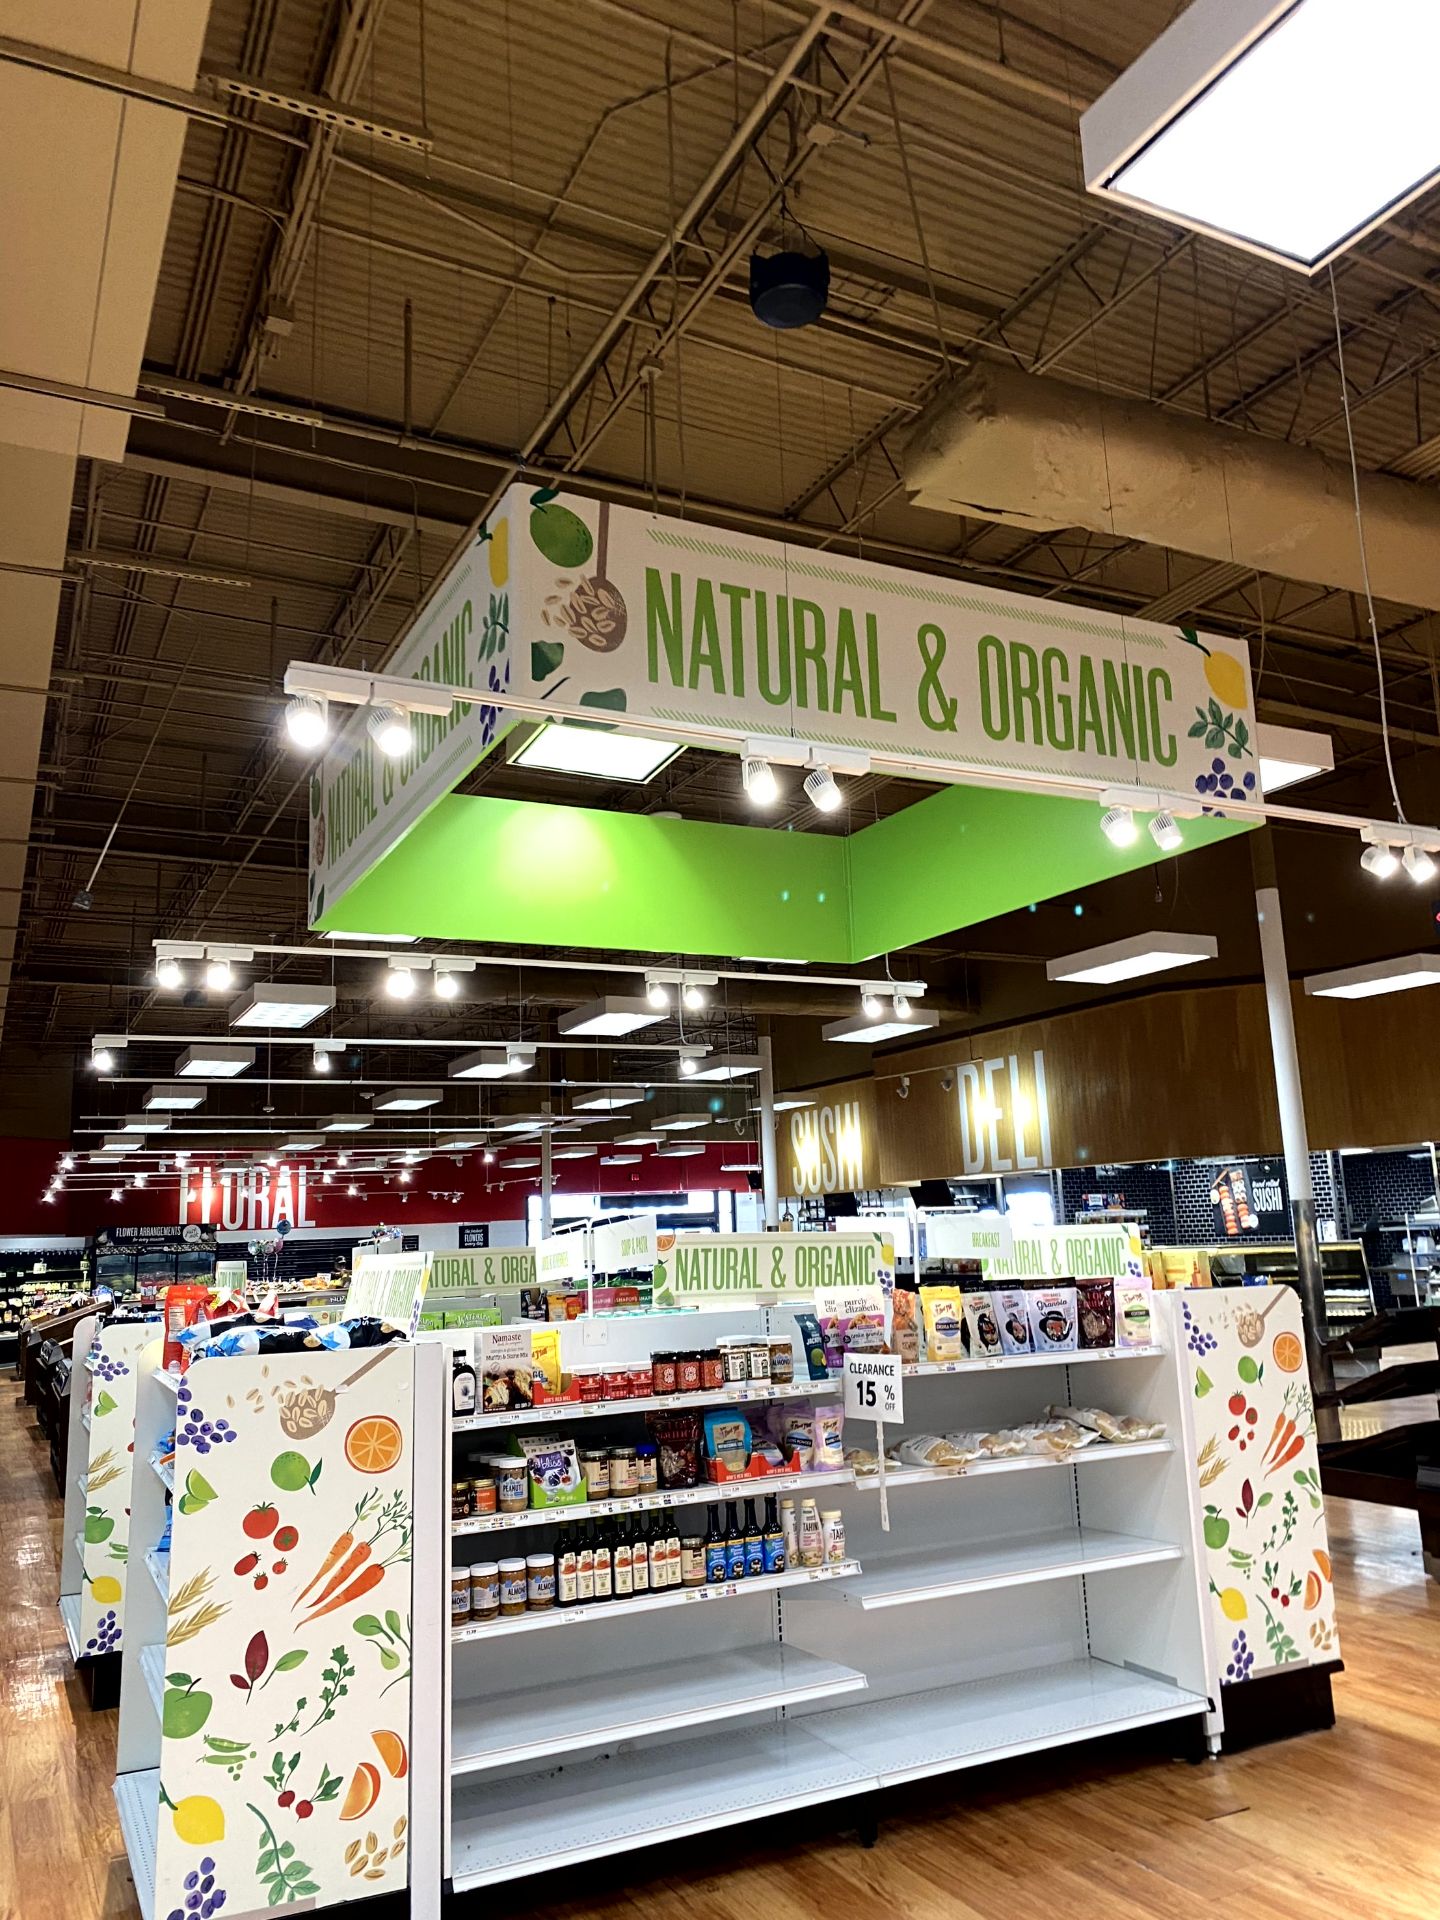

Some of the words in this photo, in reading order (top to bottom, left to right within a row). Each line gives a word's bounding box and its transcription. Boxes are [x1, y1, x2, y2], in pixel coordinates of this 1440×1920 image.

[645, 566, 898, 724] NATURAL
[917, 623, 958, 733] &
[977, 634, 1179, 768] ORGANIC
[327, 736, 378, 871] NATURAL
[400, 599, 473, 787] RGANIC
[956, 1050, 1053, 1174] DELI
[790, 1101, 864, 1194] SUSHI
[178, 1166, 317, 1231] FLORAL
[1252, 1187, 1283, 1212] SUSHI
[116, 1227, 138, 1237] FLOWER
[139, 1226, 181, 1236] ARRANGEMENTS
[464, 1233, 484, 1242] FLOWERS
[971, 1231, 1001, 1247] BREAKFAST
[1049, 1240, 1062, 1274] &
[1065, 1237, 1128, 1276] ORGANIC
[432, 1258, 479, 1289] TURAL
[484, 1256, 497, 1285] &
[501, 1255, 537, 1284] ORGA
[675, 1247, 763, 1291] NATURAL
[770, 1246, 787, 1288] &
[794, 1245, 876, 1288] ORGANIC
[844, 1298, 867, 1307] purely
[845, 1303, 881, 1313] elizabeth.
[1036, 1299, 1068, 1310] Granola
[492, 1334, 522, 1344] Namaste
[849, 1362, 895, 1376] CLEARANCE
[856, 1380, 877, 1407] 15
[884, 1385, 895, 1400] %
[884, 1403, 895, 1411] OFF
[542, 1458, 563, 1470] bliss
[502, 1484, 523, 1493] PEANUT
[832, 1528, 844, 1541] TAH
[538, 1582, 555, 1592] ALMO
